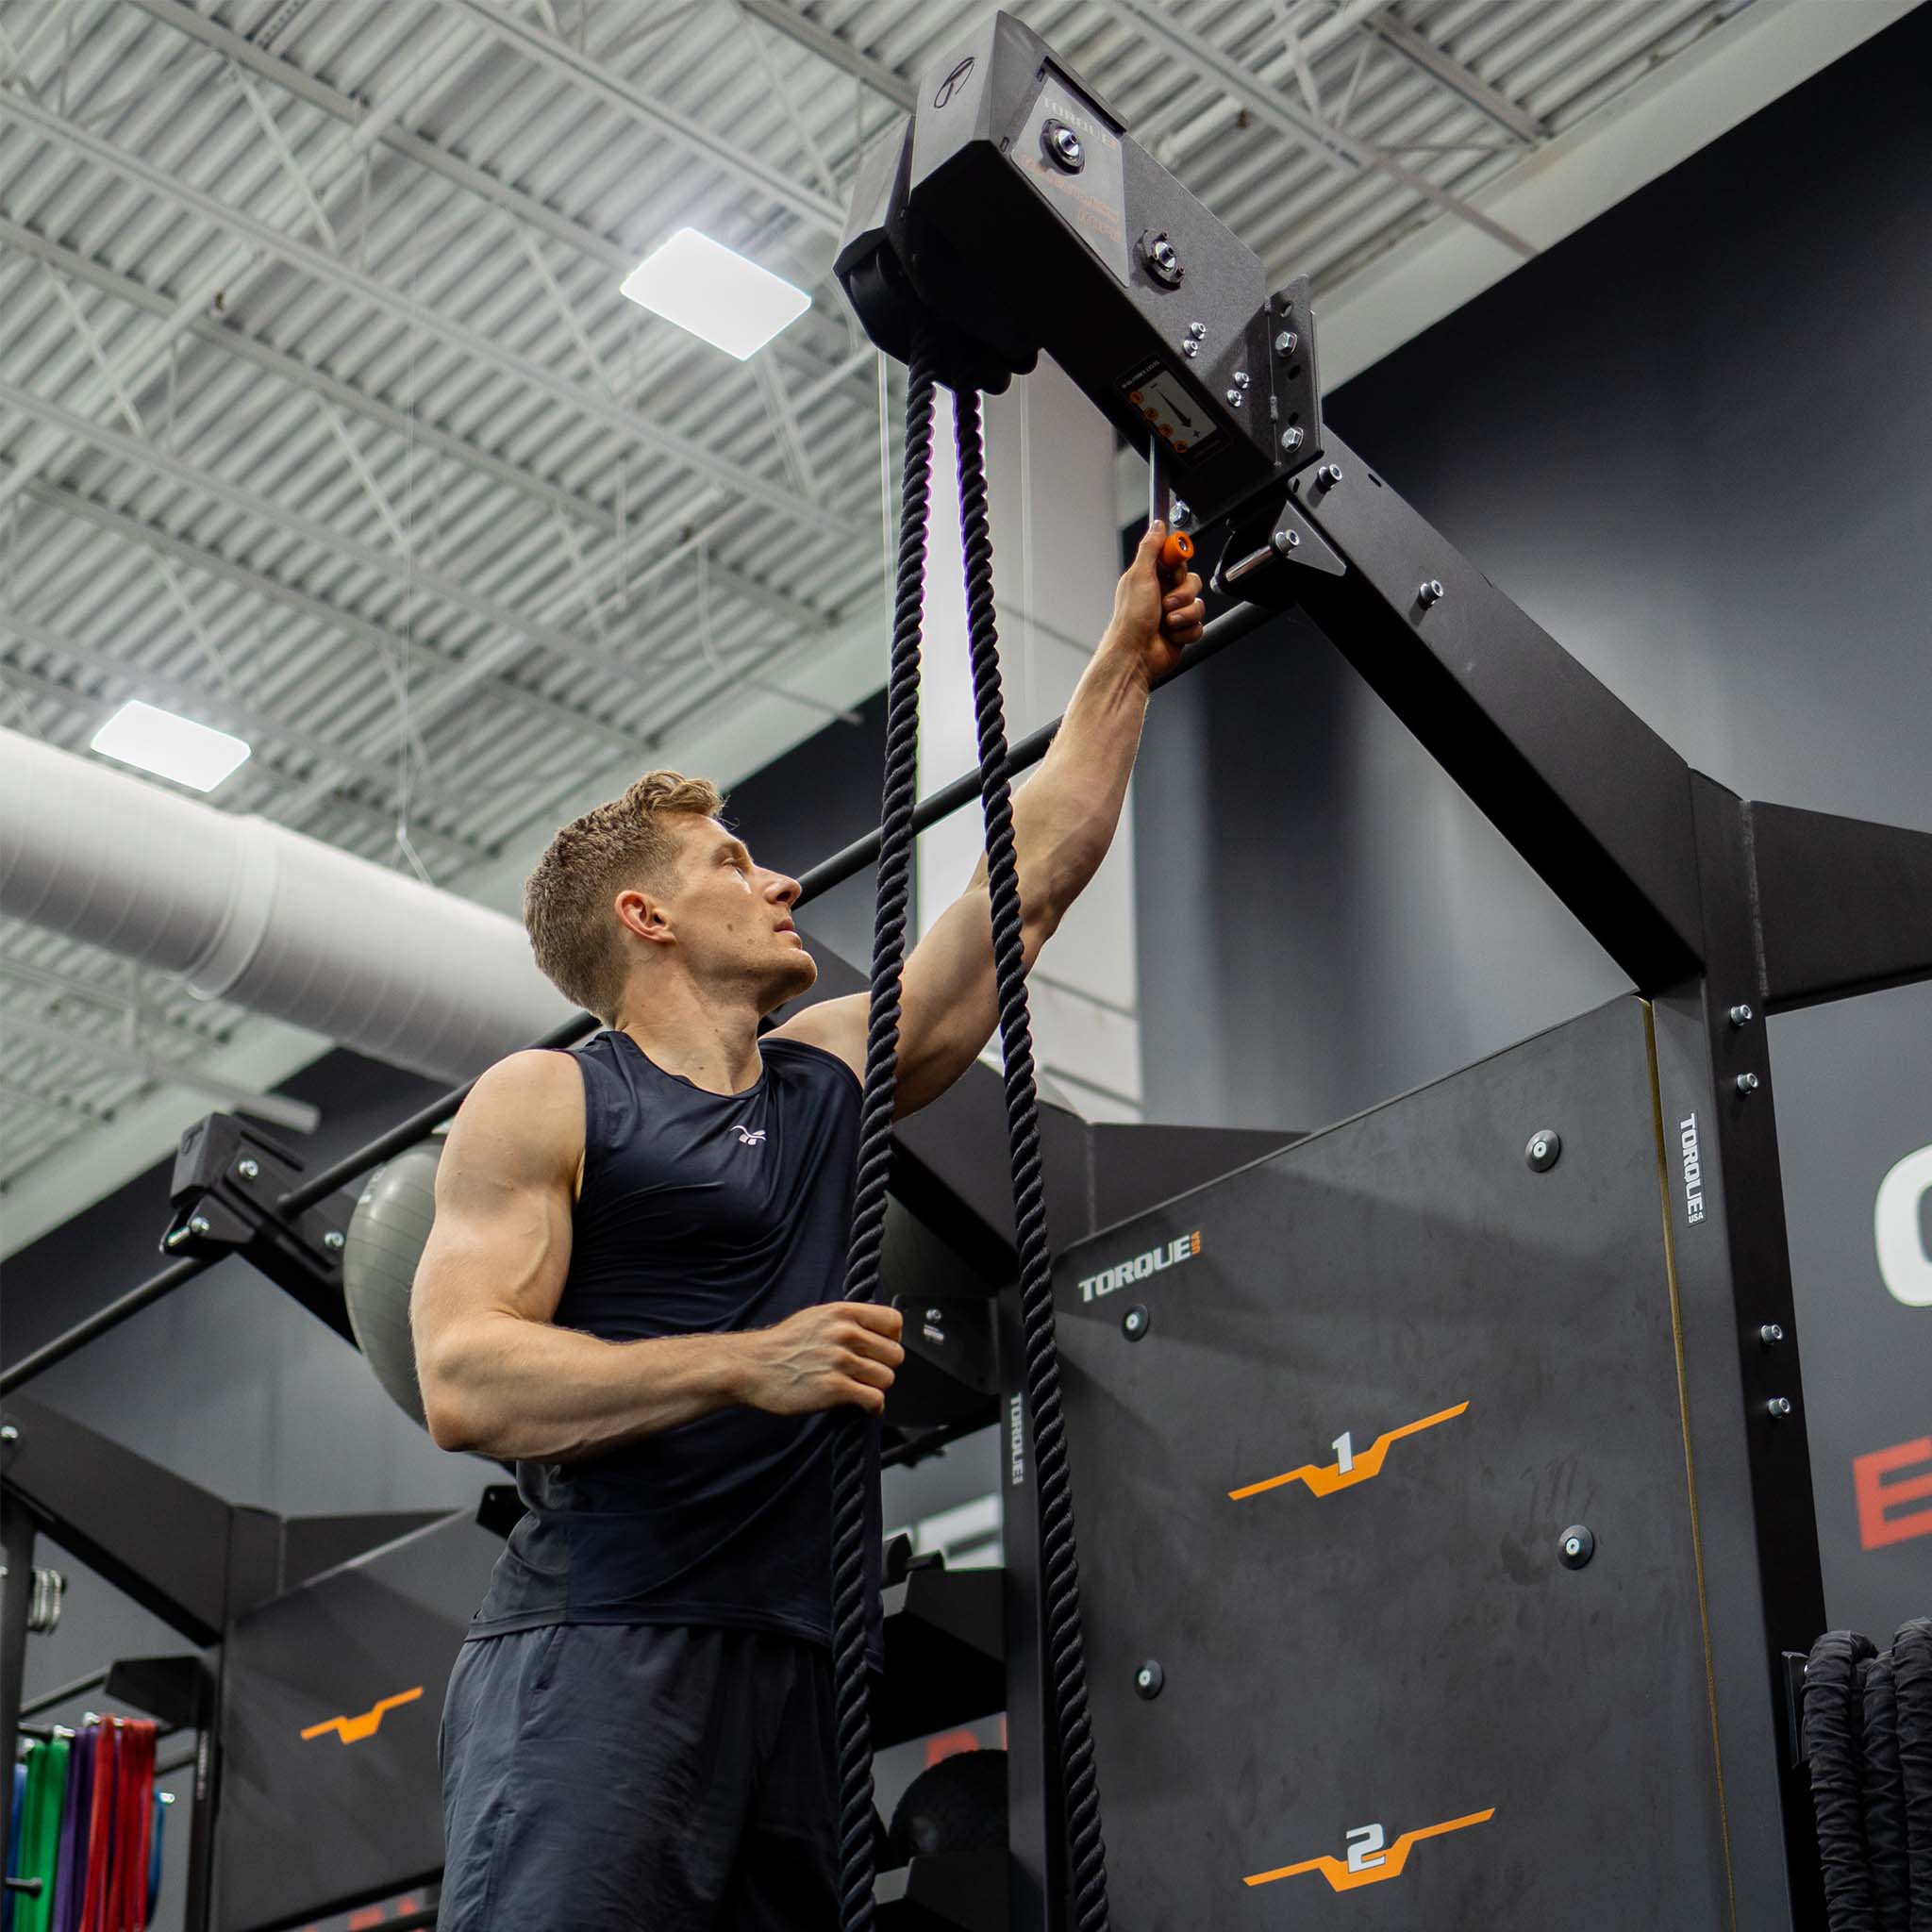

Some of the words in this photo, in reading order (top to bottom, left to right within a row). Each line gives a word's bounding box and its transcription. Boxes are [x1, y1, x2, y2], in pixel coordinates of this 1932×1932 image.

[1680, 1113, 1703, 1215] TORQUE
[1688, 1211, 1704, 1224] USA
[1077, 1235, 1191, 1303] TORQUE
[1332, 1431, 1353, 1474] 1
[1346, 1823, 1386, 1874] 2
